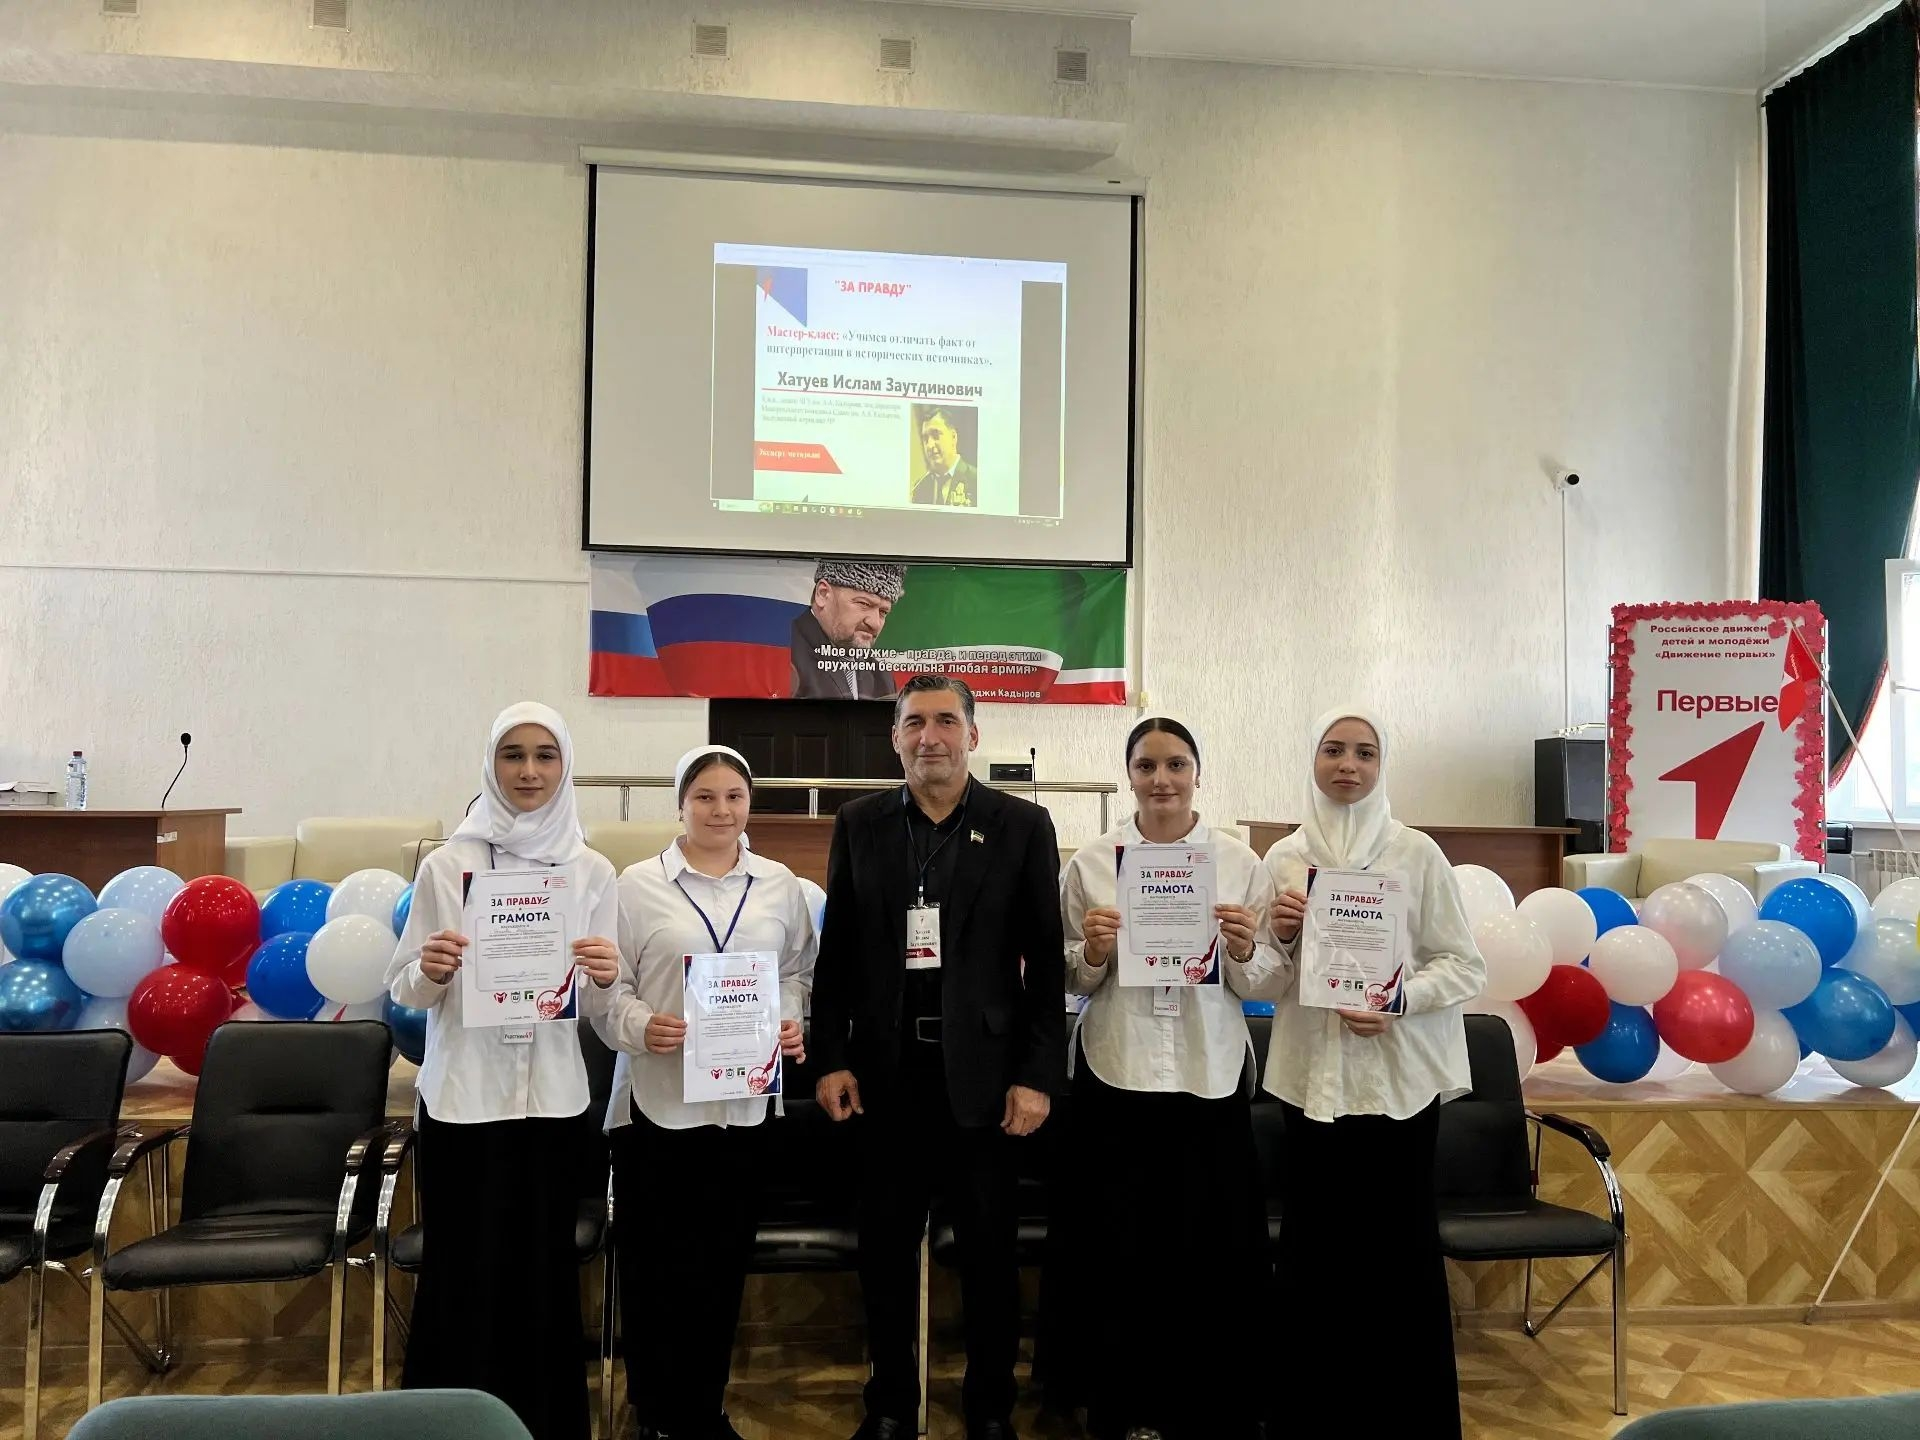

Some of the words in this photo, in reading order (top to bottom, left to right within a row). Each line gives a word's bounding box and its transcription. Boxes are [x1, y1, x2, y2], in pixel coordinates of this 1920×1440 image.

[835, 279, 855, 293] "ЗА
[858, 281, 912, 297] ПРАВДУ"
[767, 325, 840, 342] Мастер-класс:
[842, 330, 887, 345] «Учимся
[889, 334, 936, 347] отличать
[938, 335, 963, 350] факт
[965, 340, 976, 348] от
[767, 344, 844, 358] интерпретации
[846, 349, 853, 357] в
[855, 349, 924, 363] исторических
[926, 353, 993, 366] источниках».
[777, 371, 829, 393] Хатуев
[833, 375, 882, 392] Ислам
[885, 378, 983, 398] Заутдинович
[1651, 625, 1720, 633] Российское
[1662, 637, 1695, 646] детей
[1709, 637, 1770, 646] молодёжи
[814, 644, 846, 657] «Мое
[848, 648, 897, 660] оружие
[906, 650, 956, 662] правда,
[958, 651, 966, 660] и
[968, 651, 1007, 663] перед
[1008, 652, 1042, 662] этим
[1655, 651, 1721, 660] «Движение
[1724, 652, 1776, 660] первых»
[817, 660, 876, 672] оружием
[878, 661, 945, 673] бессильна
[947, 662, 989, 674] любая
[991, 665, 1038, 675] армия»
[998, 689, 1041, 699] Кадыров
[1657, 690, 1778, 719] Первые
[1141, 870, 1152, 879] ЗА
[1154, 870, 1186, 878] ПРАВДУ
[1141, 884, 1195, 894] ГРАМОТА
[490, 898, 503, 907] ЗА
[506, 896, 542, 906] ПРАВДУ
[1330, 893, 1341, 902] ЗА
[1344, 894, 1378, 904] ПРАВДУ
[491, 912, 551, 924] ГРАМОТА
[1329, 907, 1383, 920] ГРАМОТА
[708, 980, 719, 989] ЗА
[721, 978, 751, 987] ПРАВДУ
[709, 993, 759, 1005] ГРАМОТА
